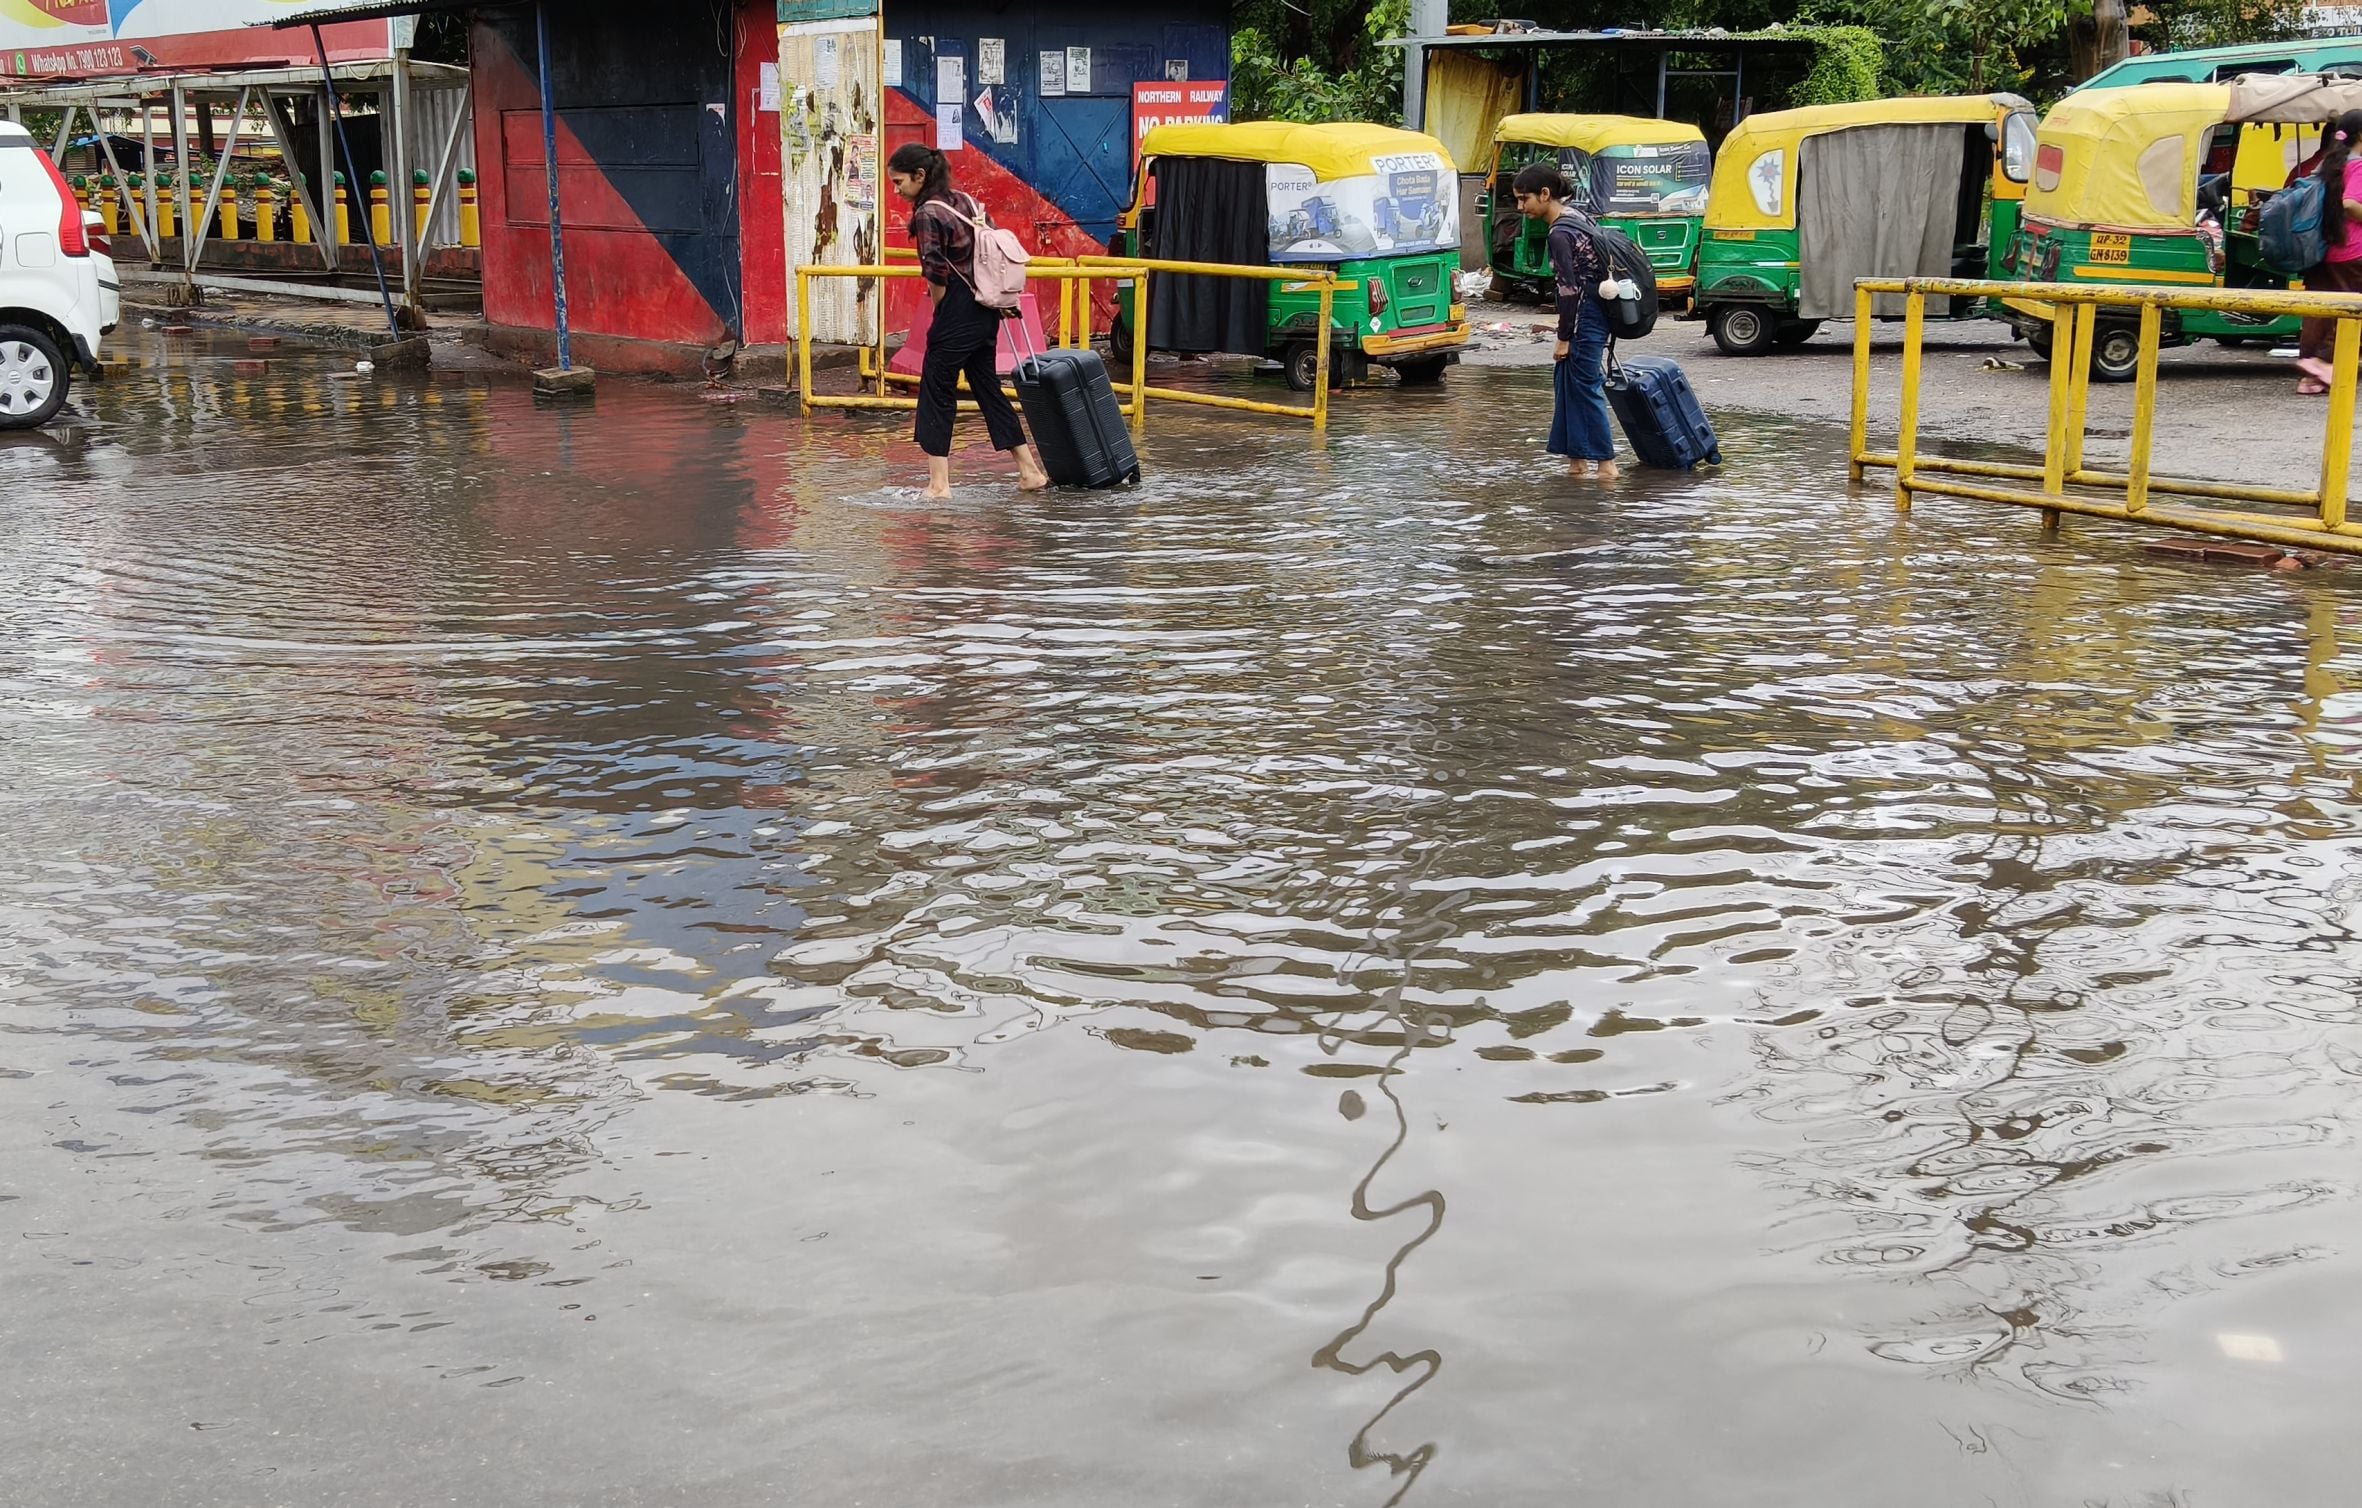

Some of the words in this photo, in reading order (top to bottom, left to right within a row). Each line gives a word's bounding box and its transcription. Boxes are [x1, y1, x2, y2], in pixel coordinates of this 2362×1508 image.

[31, 52, 66, 75] WhatsApp
[65, 51, 78, 71] No.
[93, 47, 108, 68] 123
[108, 46, 123, 67] 123
[1138, 91, 1181, 103] NORTHERN
[1190, 90, 1224, 102] RAILWAY
[1616, 164, 1641, 174] ICON
[1643, 164, 1672, 174] SOLAR
[2096, 234, 2127, 245] UP-32
